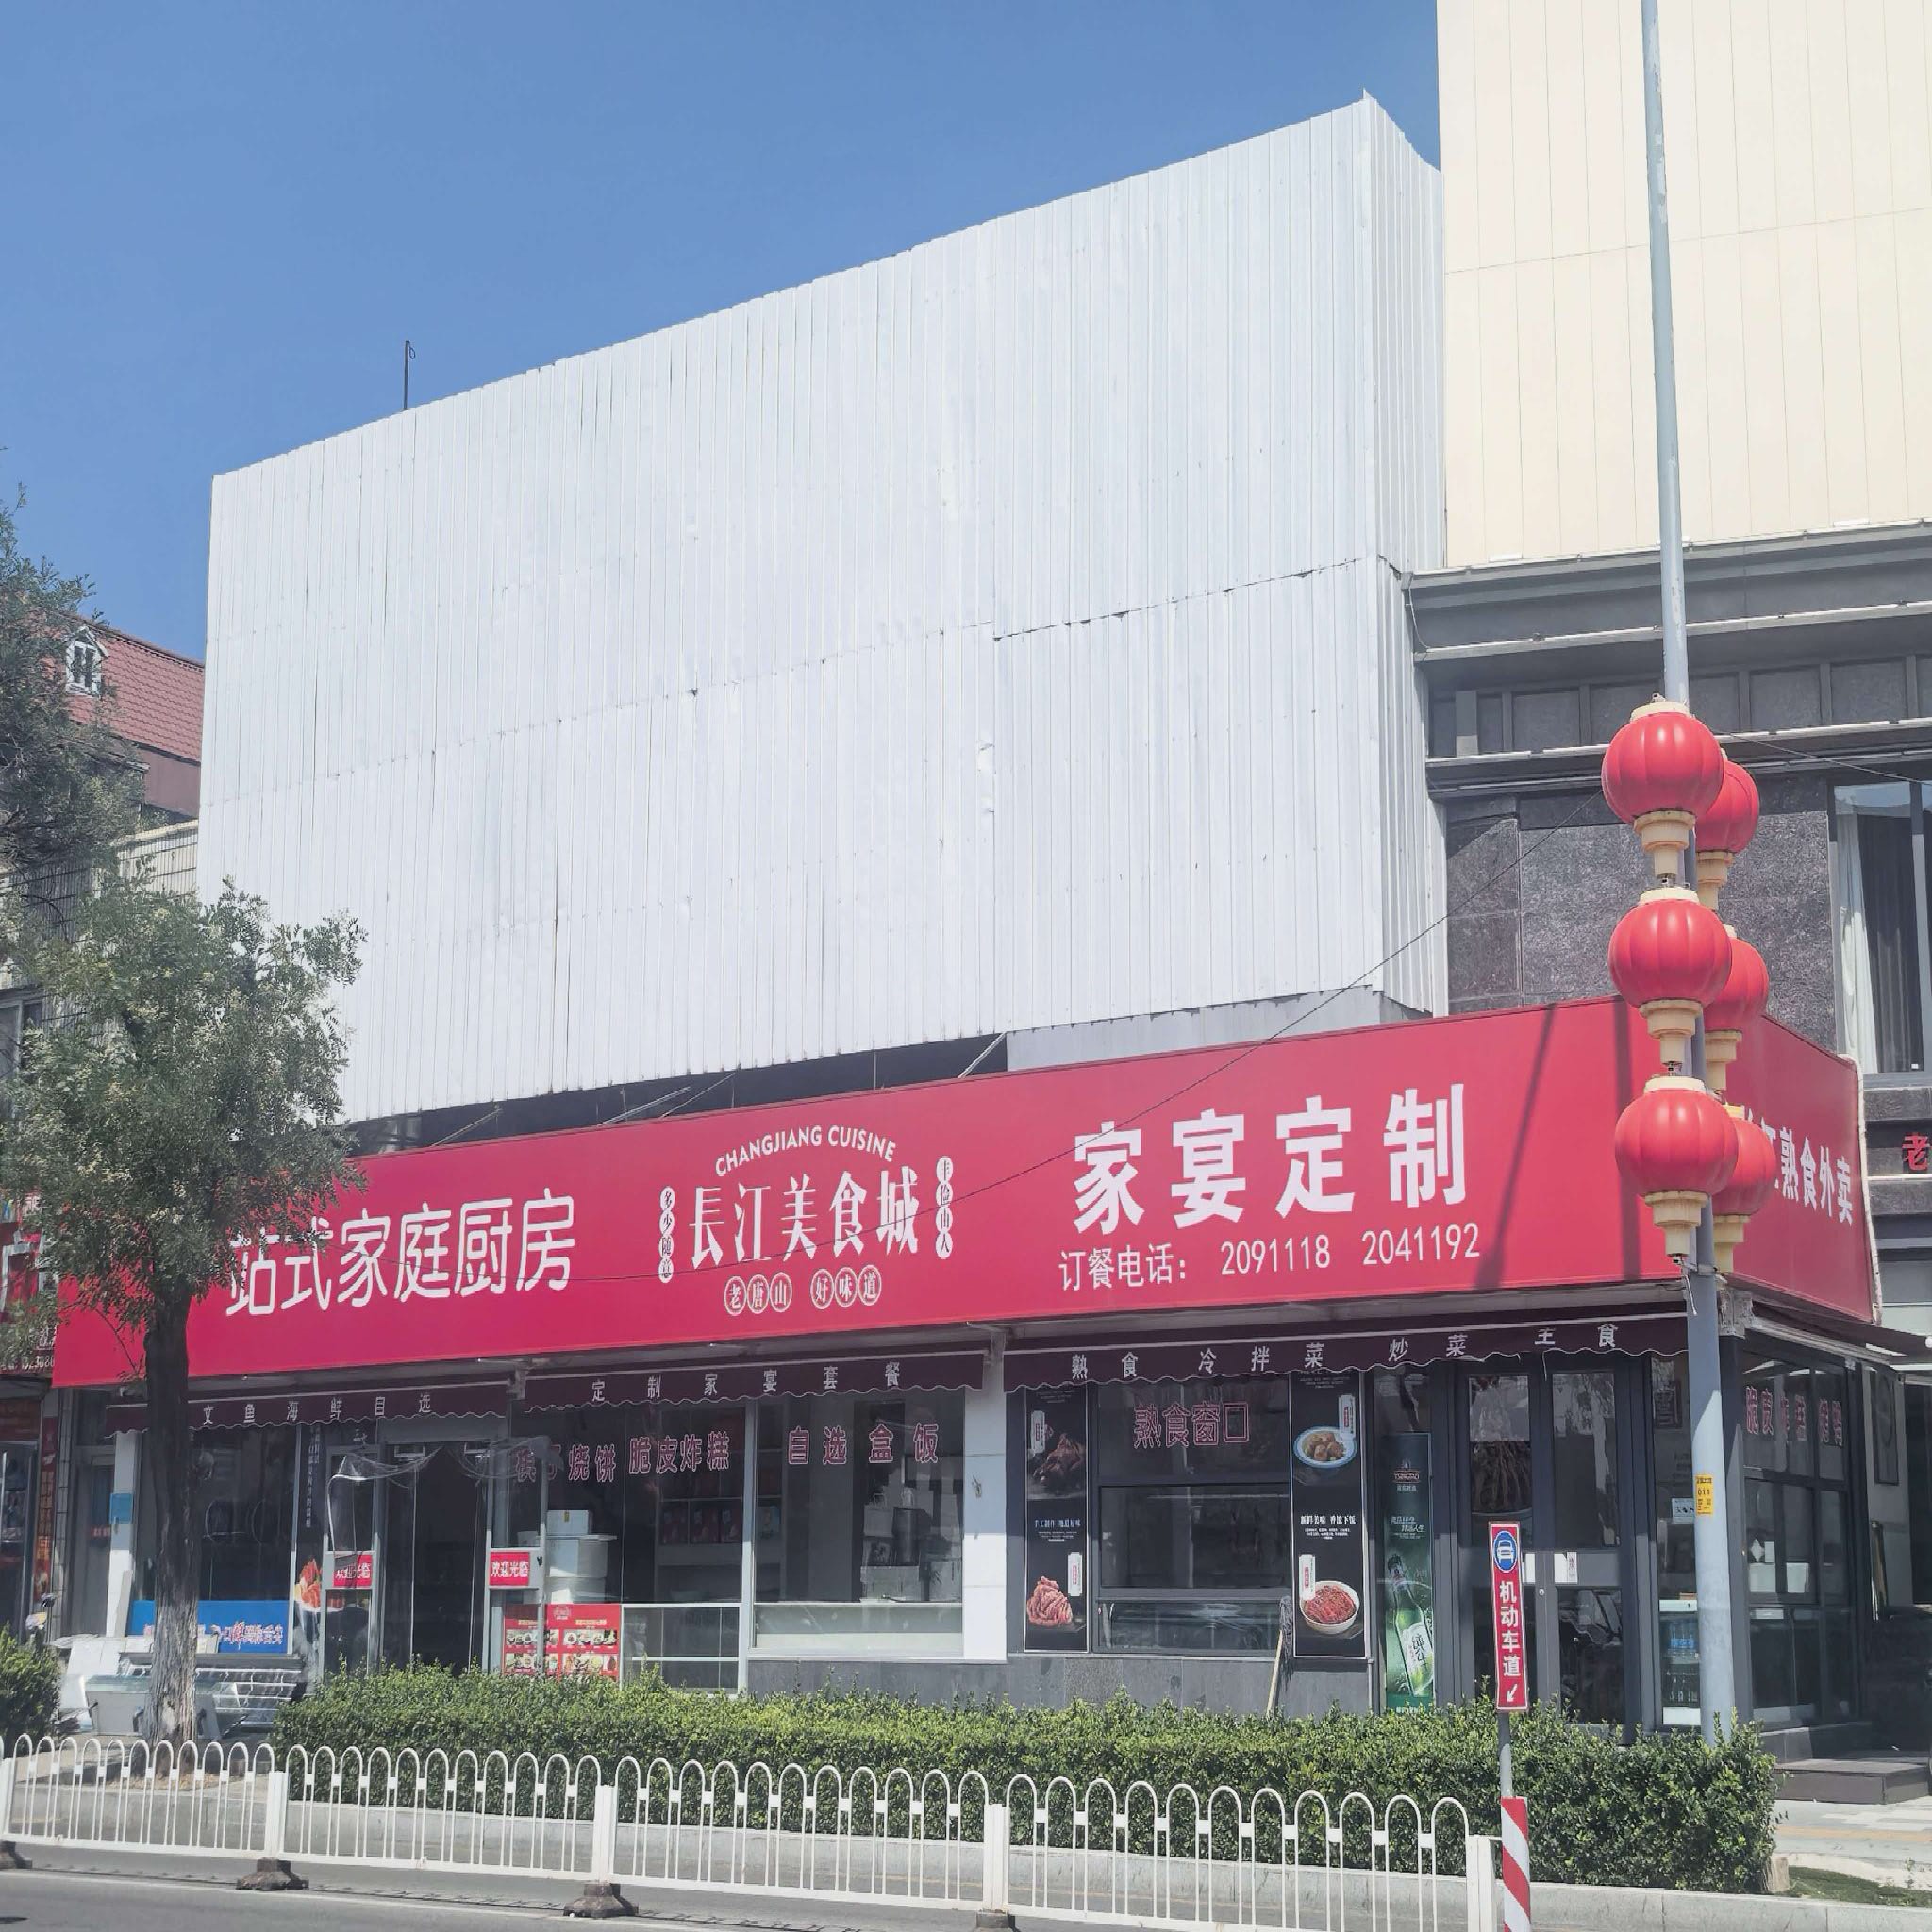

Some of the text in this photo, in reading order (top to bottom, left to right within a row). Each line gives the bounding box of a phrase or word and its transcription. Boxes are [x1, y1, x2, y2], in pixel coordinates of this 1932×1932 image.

[715, 1124, 896, 1176] CHANGJIANG CUISINE
[1074, 1083, 1467, 1235] 家宴定制
[1748, 1108, 1853, 1226] 熟食外卖
[1901, 1135, 1930, 1171] 老
[659, 1188, 675, 1281] 多少随意
[1221, 1235, 1331, 1275] 2091118
[1360, 1223, 1480, 1265] 2041192
[727, 1269, 879, 1312] 老唐山 好味道
[1072, 1324, 1618, 1380] 熟食 冷拌菜 炒菜 主食
[591, 1361, 900, 1402] 定制家宴套餐
[788, 1423, 939, 1465] 自选盒饭
[1134, 1400, 1249, 1449] 熟食窗口
[628, 1431, 730, 1475] 脆皮炸糕
[491, 1561, 529, 1578] 欢迎光临
[1500, 1580, 1521, 1677] 机动车道
